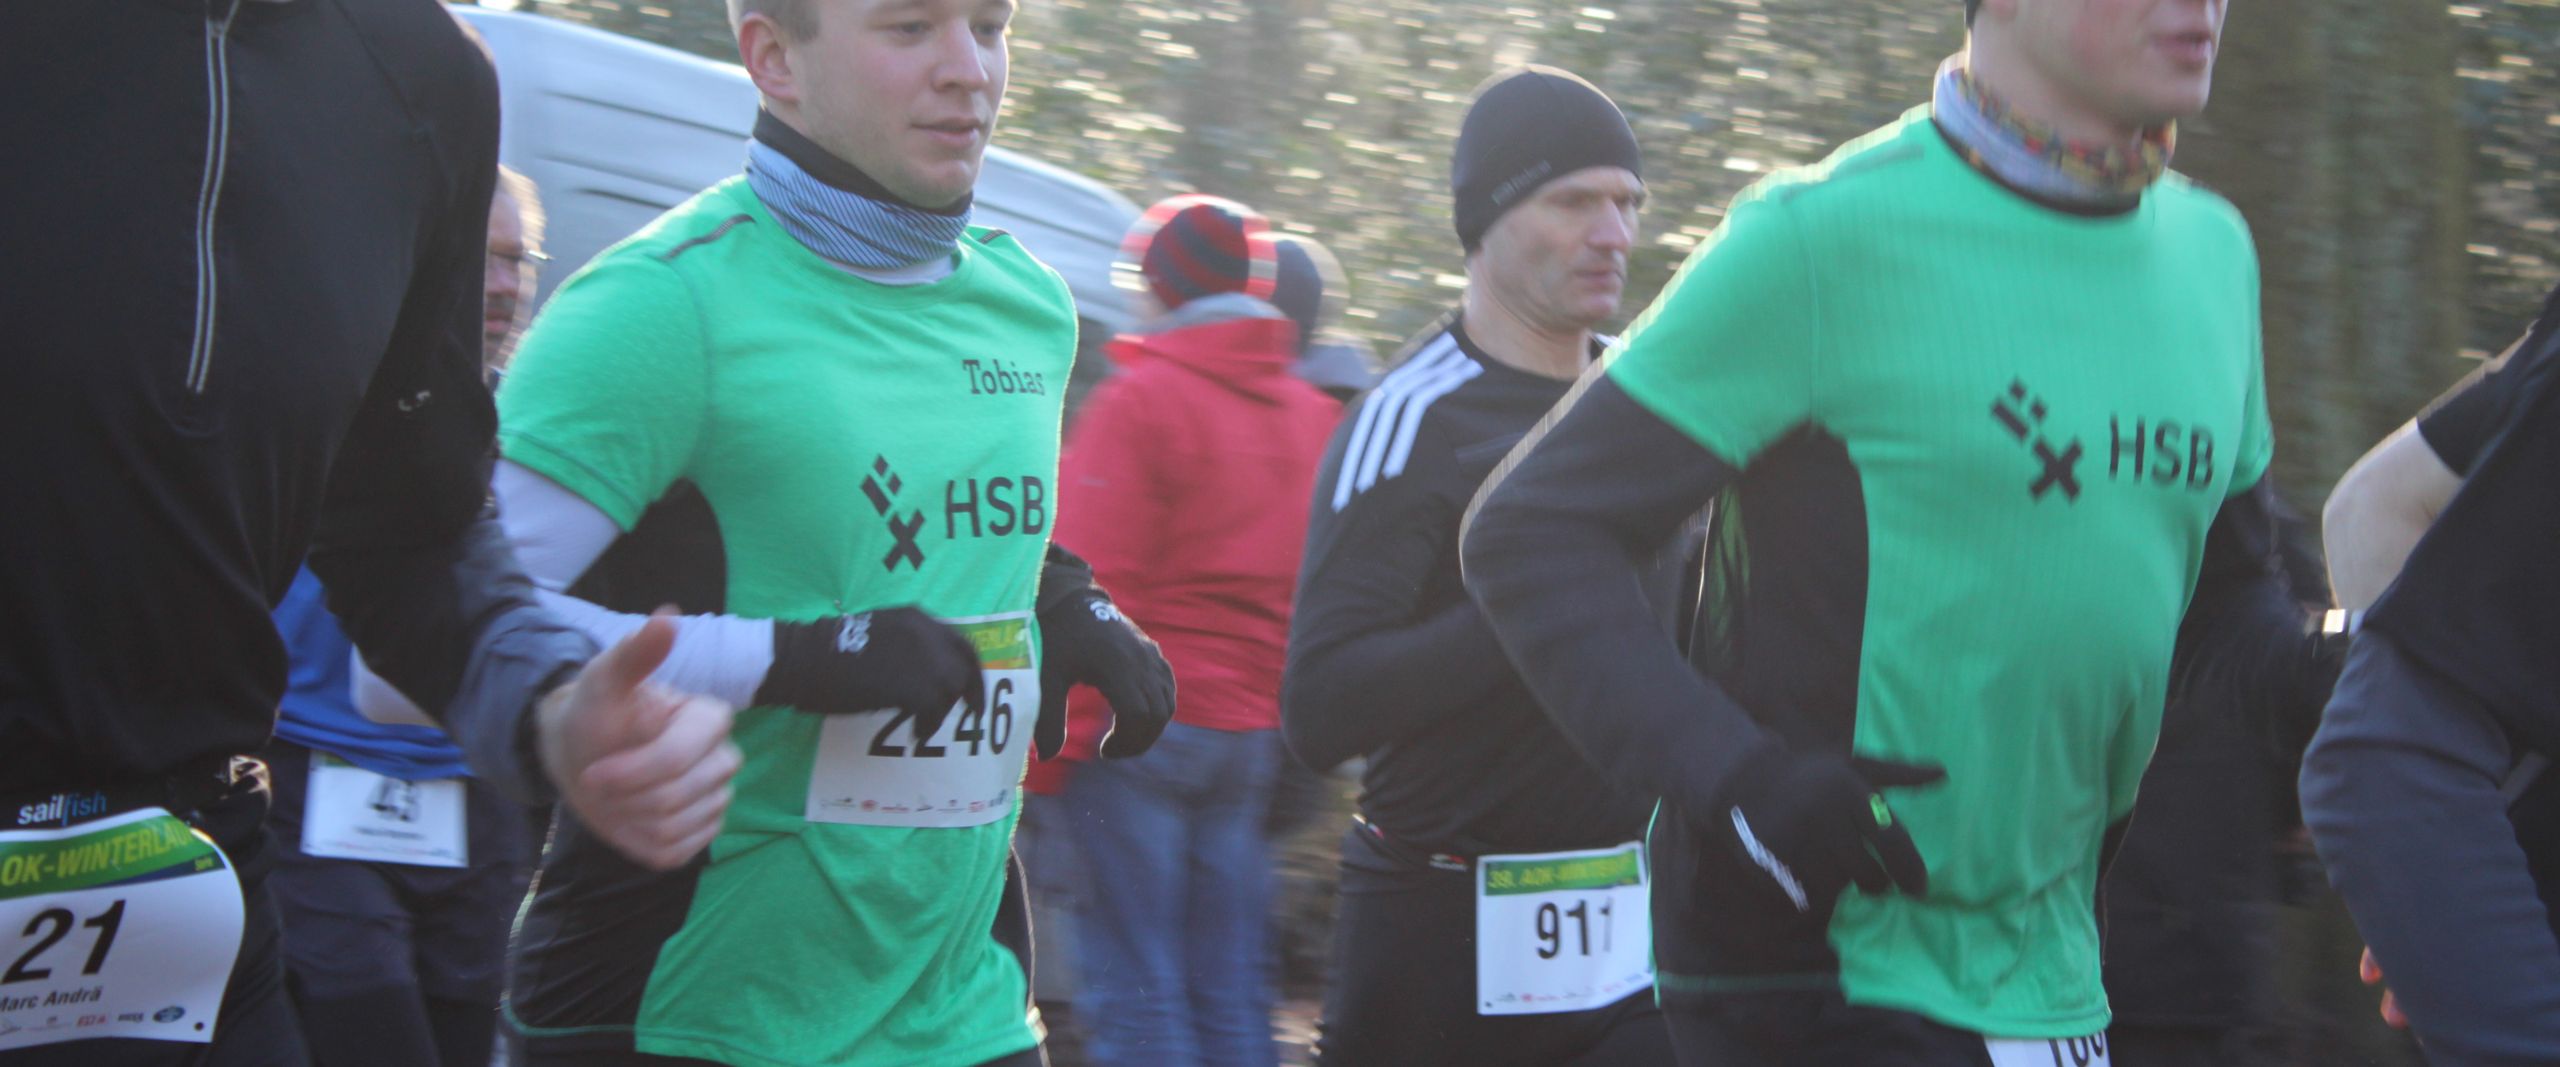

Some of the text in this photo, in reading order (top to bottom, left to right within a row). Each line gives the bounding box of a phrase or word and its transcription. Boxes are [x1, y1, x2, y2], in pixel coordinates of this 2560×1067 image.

[962, 358, 1046, 396] Tobias
[2108, 411, 2214, 492] HSB
[945, 475, 1045, 540] HSB
[17, 791, 107, 827] sailfish
[2, 898, 126, 984] 21
[1535, 895, 1613, 960] 911
